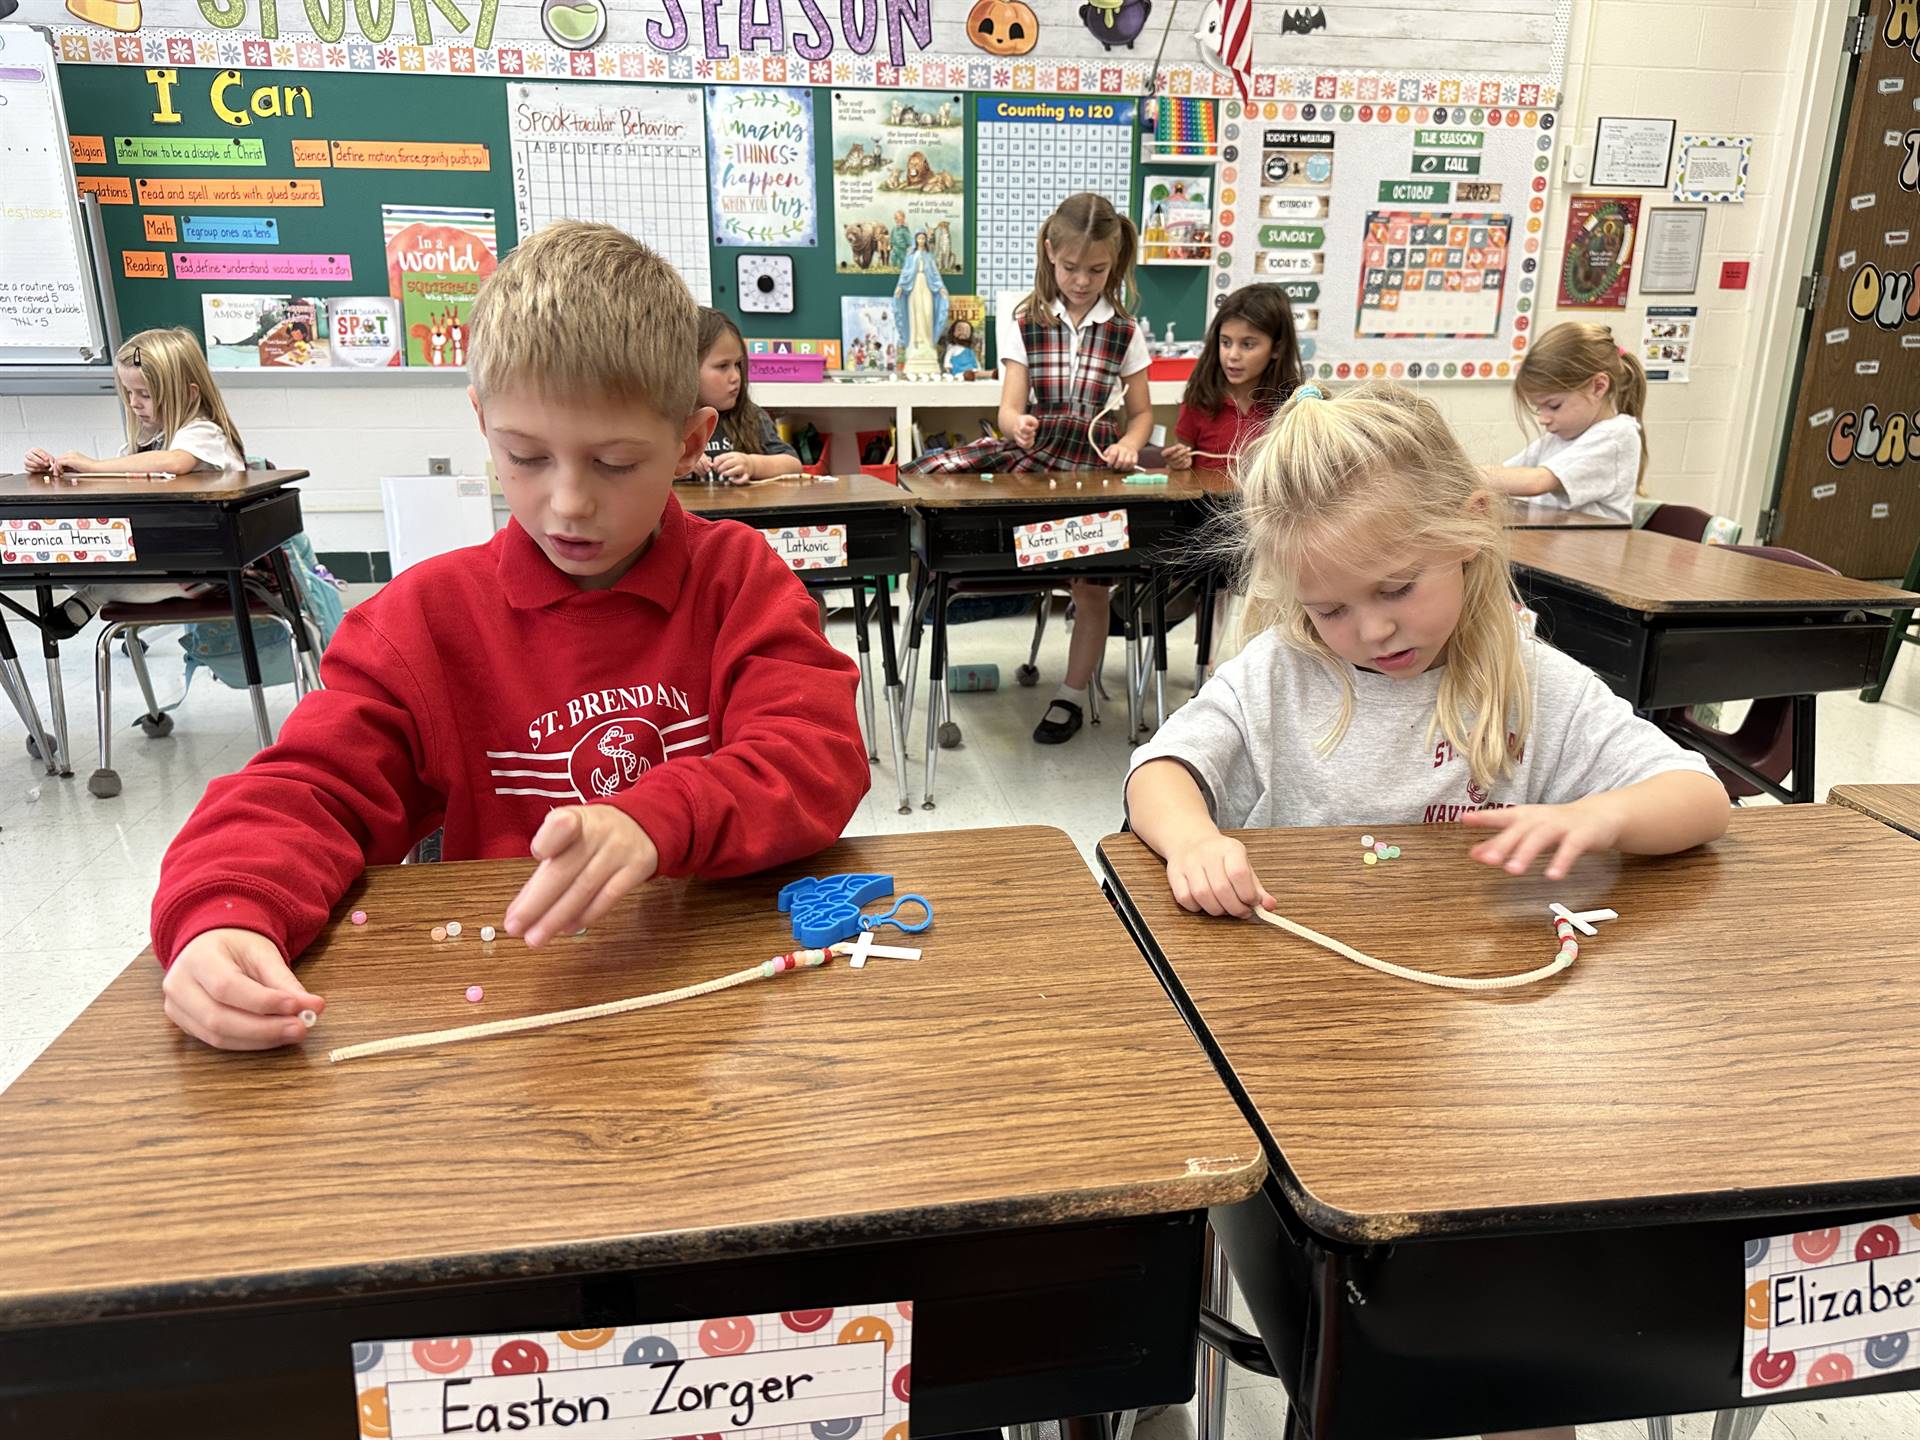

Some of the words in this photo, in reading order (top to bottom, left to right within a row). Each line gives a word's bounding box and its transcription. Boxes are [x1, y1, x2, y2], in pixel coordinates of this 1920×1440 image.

[145, 69, 182, 124] I
[210, 69, 313, 127] Can
[996, 102, 1065, 122] Counting
[1069, 104, 1084, 118] to
[1088, 105, 1114, 118] 120
[517, 104, 615, 133] Spooktacular
[620, 108, 683, 138] Behavior
[1266, 132, 1298, 143] TODAY'S
[1421, 132, 1436, 144] THE
[1440, 132, 1478, 146] SEASON
[118, 146, 138, 158] show
[143, 146, 158, 157] how
[161, 146, 170, 158] to
[172, 145, 182, 158] be
[185, 150, 190, 158] a
[192, 145, 220, 161] disciple
[224, 145, 231, 159] of
[237, 144, 263, 160] Christ
[295, 147, 327, 161] Science
[336, 147, 364, 162] define
[533, 141, 542, 152] A
[549, 143, 556, 153] B
[563, 144, 570, 154] C
[577, 144, 586, 154] D
[592, 144, 599, 154] E
[604, 145, 610, 155] F
[615, 144, 622, 156] G
[628, 145, 636, 156] H
[643, 146, 650, 156] I
[654, 146, 661, 156] J
[666, 146, 673, 156] K
[679, 146, 688, 156] L
[691, 146, 701, 156] M
[736, 143, 789, 165] THINGS
[518, 152, 522, 164] 1
[1444, 157, 1468, 172] FALL
[517, 169, 526, 180] 2
[722, 162, 803, 195] happen
[141, 184, 164, 199] read
[167, 185, 184, 199] and
[188, 185, 208, 202] spell
[213, 186, 240, 200] words
[244, 187, 262, 200] with
[266, 186, 289, 203] glued
[519, 185, 527, 197] 3
[1392, 184, 1434, 200] OCTOBER
[1464, 184, 1491, 200] 2023
[519, 202, 528, 213] 4
[722, 198, 746, 210] WHEN
[749, 198, 768, 211] YOU
[146, 220, 173, 237] Math
[520, 218, 528, 231] 5
[186, 227, 218, 240] regroup
[221, 228, 239, 238] ones
[243, 229, 252, 238] as
[253, 224, 271, 239] tens
[1268, 230, 1315, 244] SUNDAY
[1377, 229, 1383, 239] 1
[1416, 230, 1424, 240] 3
[1434, 229, 1442, 240] 4
[1474, 232, 1482, 243] 6
[416, 236, 432, 249] In
[436, 239, 444, 249] a
[398, 243, 480, 273] world
[1392, 253, 1401, 263] 9
[1412, 252, 1424, 262] 10
[1431, 253, 1445, 262] 11
[1450, 253, 1461, 262] 12
[125, 257, 165, 275] Reading
[1370, 274, 1383, 284] 15
[1388, 275, 1401, 284] 16
[1408, 275, 1420, 284] 17
[20, 282, 54, 291] routine
[57, 281, 74, 292] has
[1286, 286, 1312, 298] DAY
[52, 293, 58, 302] 5
[1365, 294, 1379, 304] 22
[22, 304, 42, 313] color
[214, 309, 242, 320] AMOS
[949, 309, 980, 321] IBLE
[10, 532, 64, 546] Veronica
[70, 530, 111, 545] Harris
[1027, 534, 1058, 548] Kateri
[1065, 522, 1104, 542] Molseed
[786, 538, 829, 553] Latkovic
[528, 710, 564, 750] ST.
[566, 682, 691, 728] BRENDAN
[1775, 1260, 1920, 1328] Elizabe
[442, 1377, 609, 1434] Easton
[649, 1359, 814, 1427] Zorger
